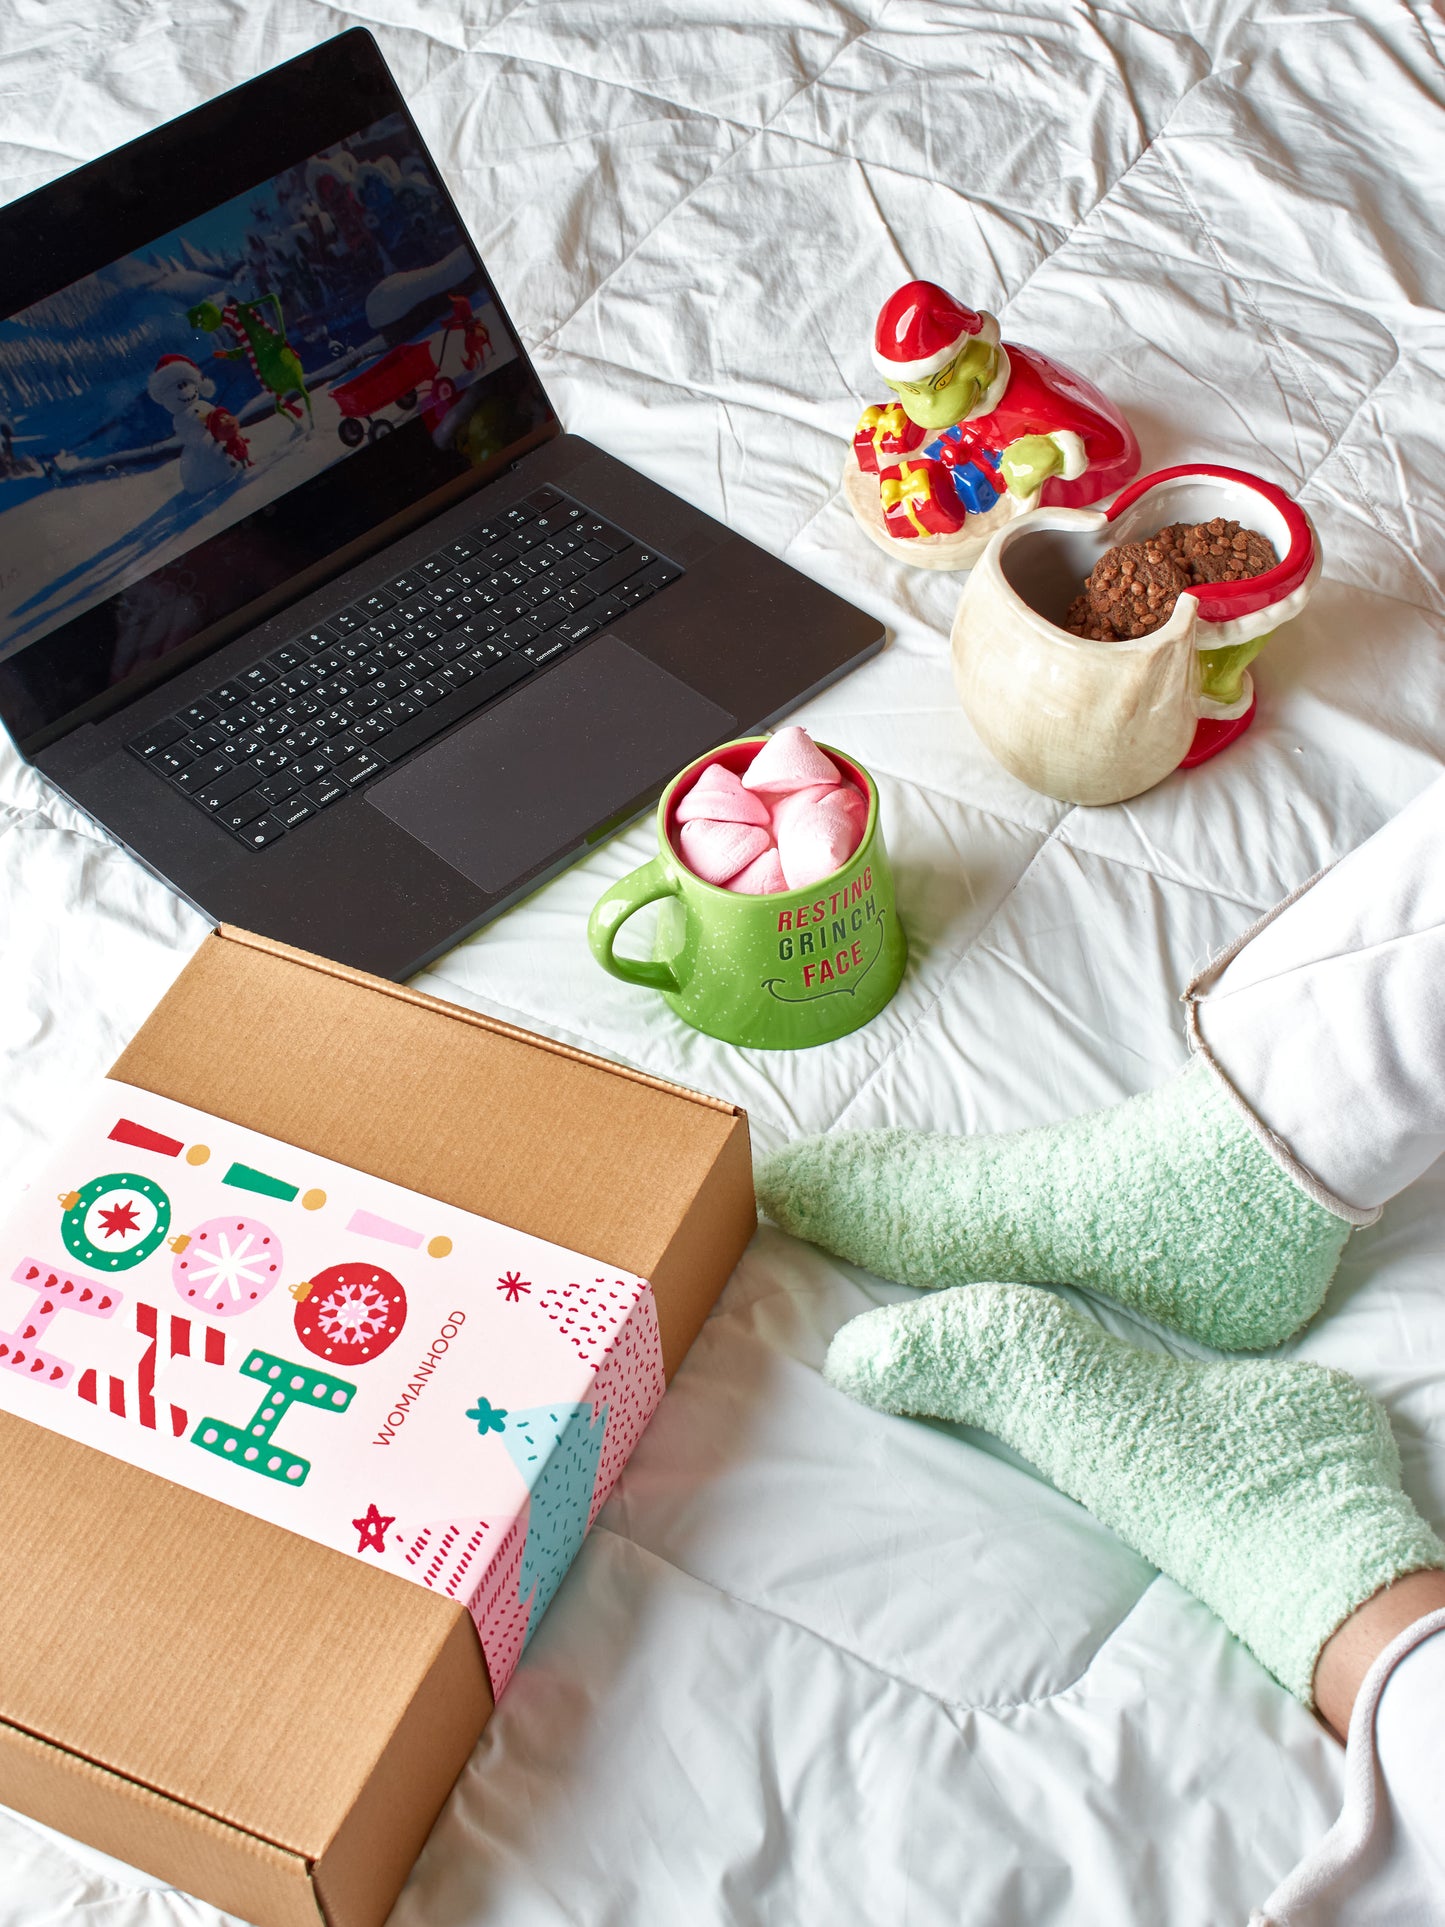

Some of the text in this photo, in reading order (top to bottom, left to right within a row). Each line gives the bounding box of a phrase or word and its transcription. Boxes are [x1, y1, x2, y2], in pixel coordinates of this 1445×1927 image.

[571, 625, 590, 638] option
[536, 642, 563, 662] command
[349, 762, 378, 783] command
[320, 788, 340, 802] option
[287, 808, 309, 823] control
[777, 866, 873, 933] RESTING
[778, 895, 876, 961] GRINCH
[802, 940, 864, 988] FACE
[372, 1310, 467, 1447] WOMANHOOD
